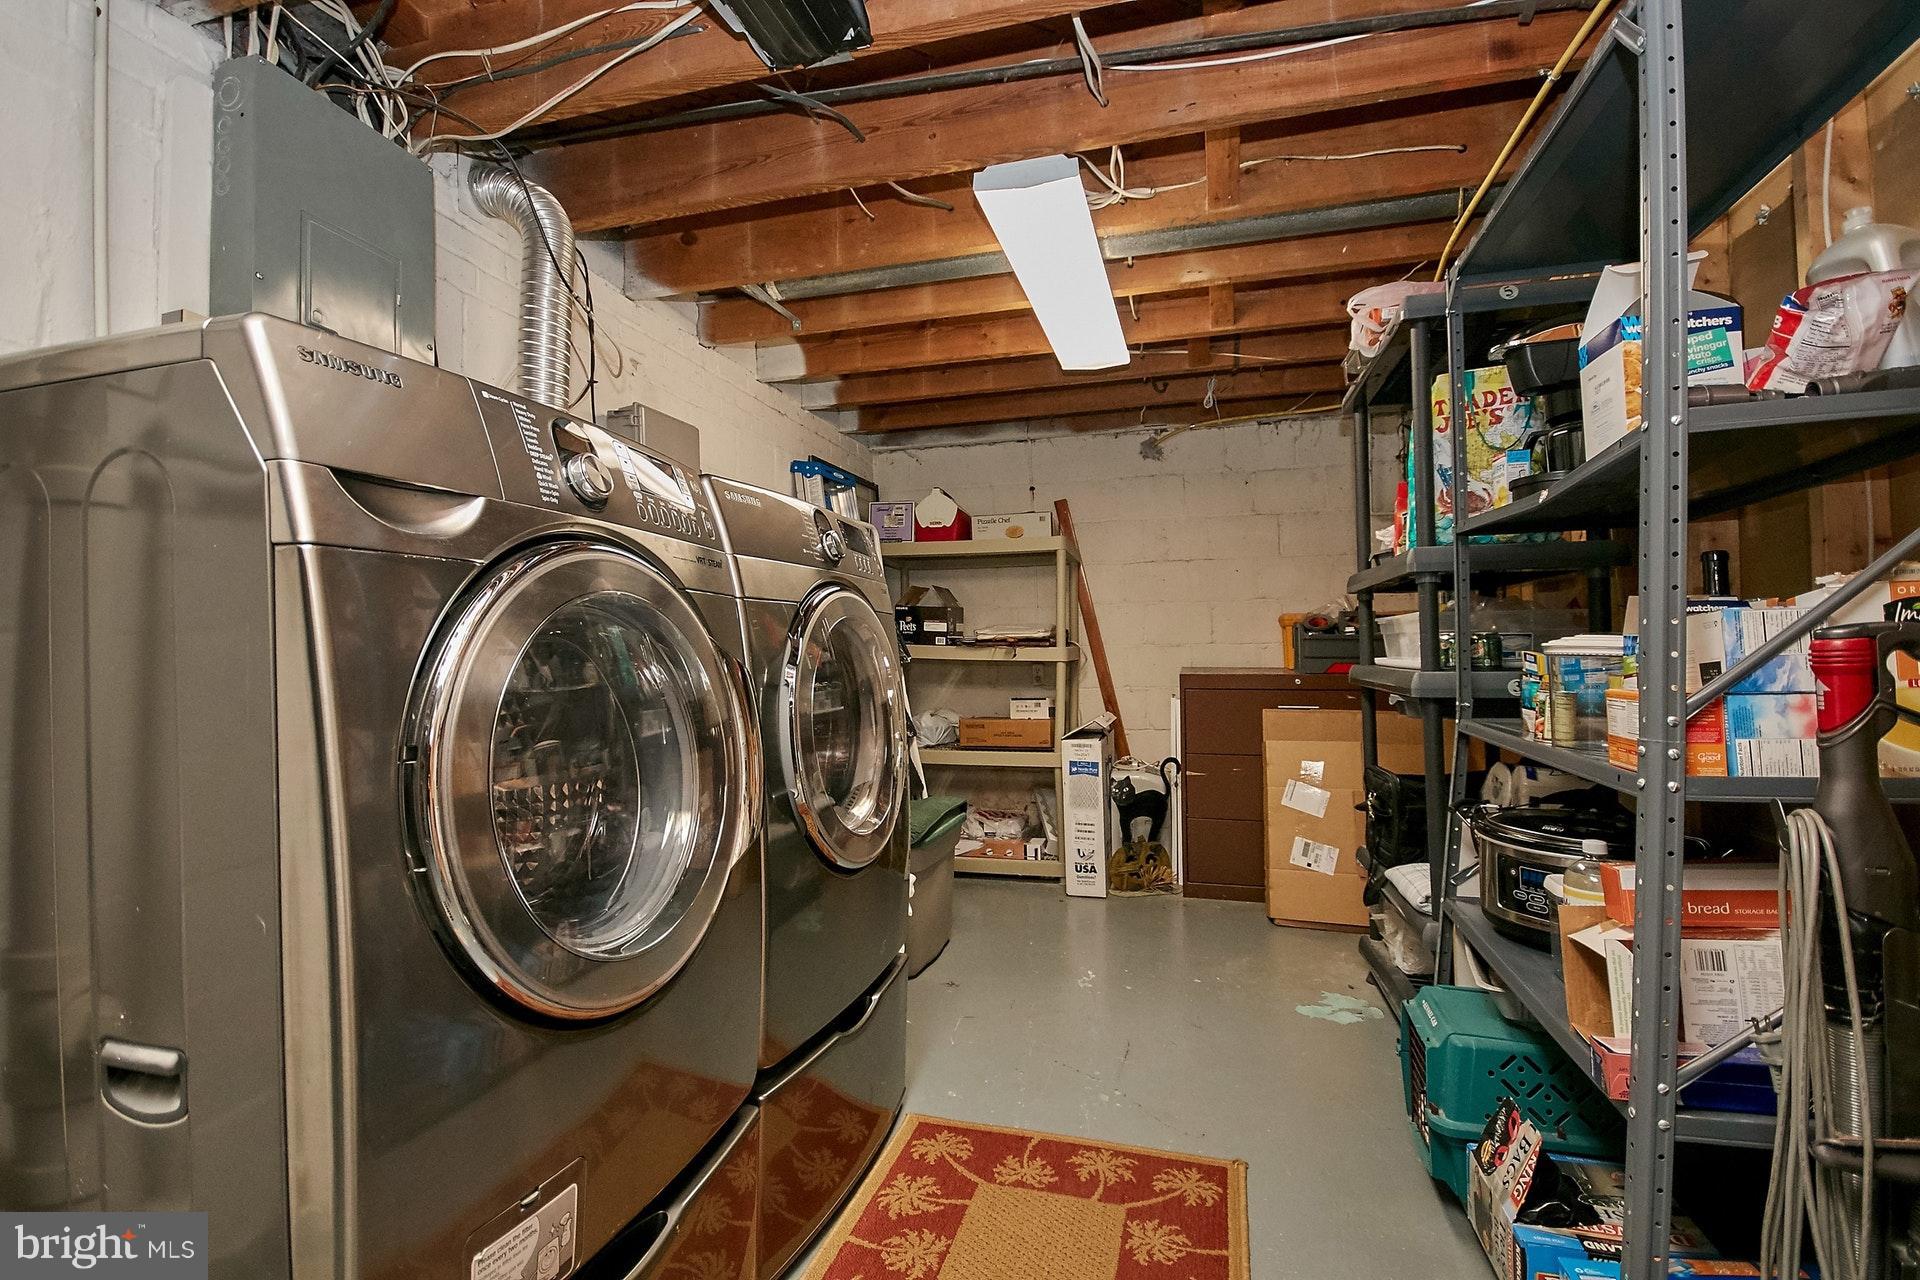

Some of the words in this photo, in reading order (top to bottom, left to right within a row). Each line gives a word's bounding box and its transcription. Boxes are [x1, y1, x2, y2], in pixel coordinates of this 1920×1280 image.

[1503, 285, 1514, 297] 5
[297, 345, 403, 388] SAMSUNG
[724, 490, 761, 508] SAMSUNG
[1897, 585, 1920, 595] OR
[1074, 864, 1098, 874] USA
[1687, 902, 1730, 915] bread
[1502, 1136, 1532, 1190] BAGS
[496, 1239, 512, 1253] clean
[521, 1223, 533, 1235] filter
[492, 1252, 507, 1265] every
